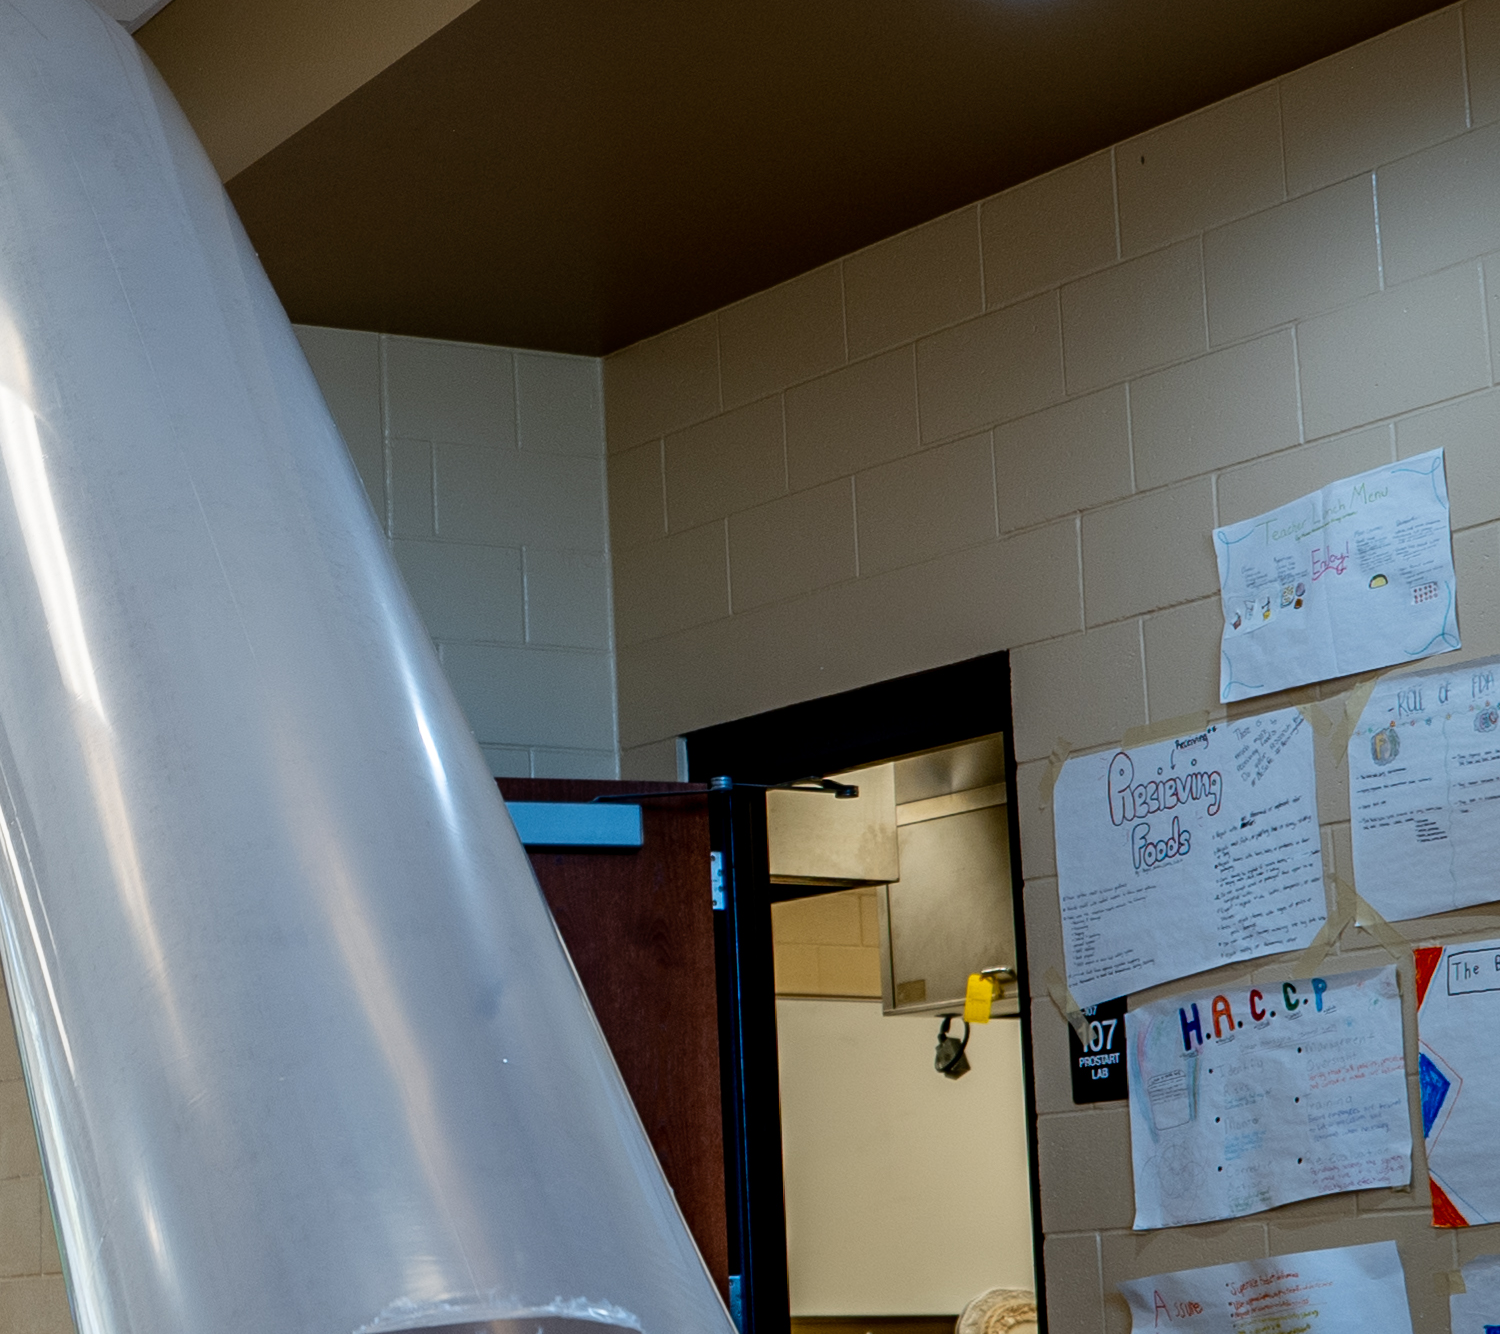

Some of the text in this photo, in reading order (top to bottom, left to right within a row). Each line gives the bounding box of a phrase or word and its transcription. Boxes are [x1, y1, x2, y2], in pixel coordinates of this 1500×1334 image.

[1350, 482, 1389, 509] Menu
[1471, 671, 1496, 699] FDA
[1131, 815, 1192, 869] Foods
[1452, 961, 1480, 981] The
[1079, 1052, 1120, 1068] PROSTART
[1091, 1067, 1110, 1080] LAB
